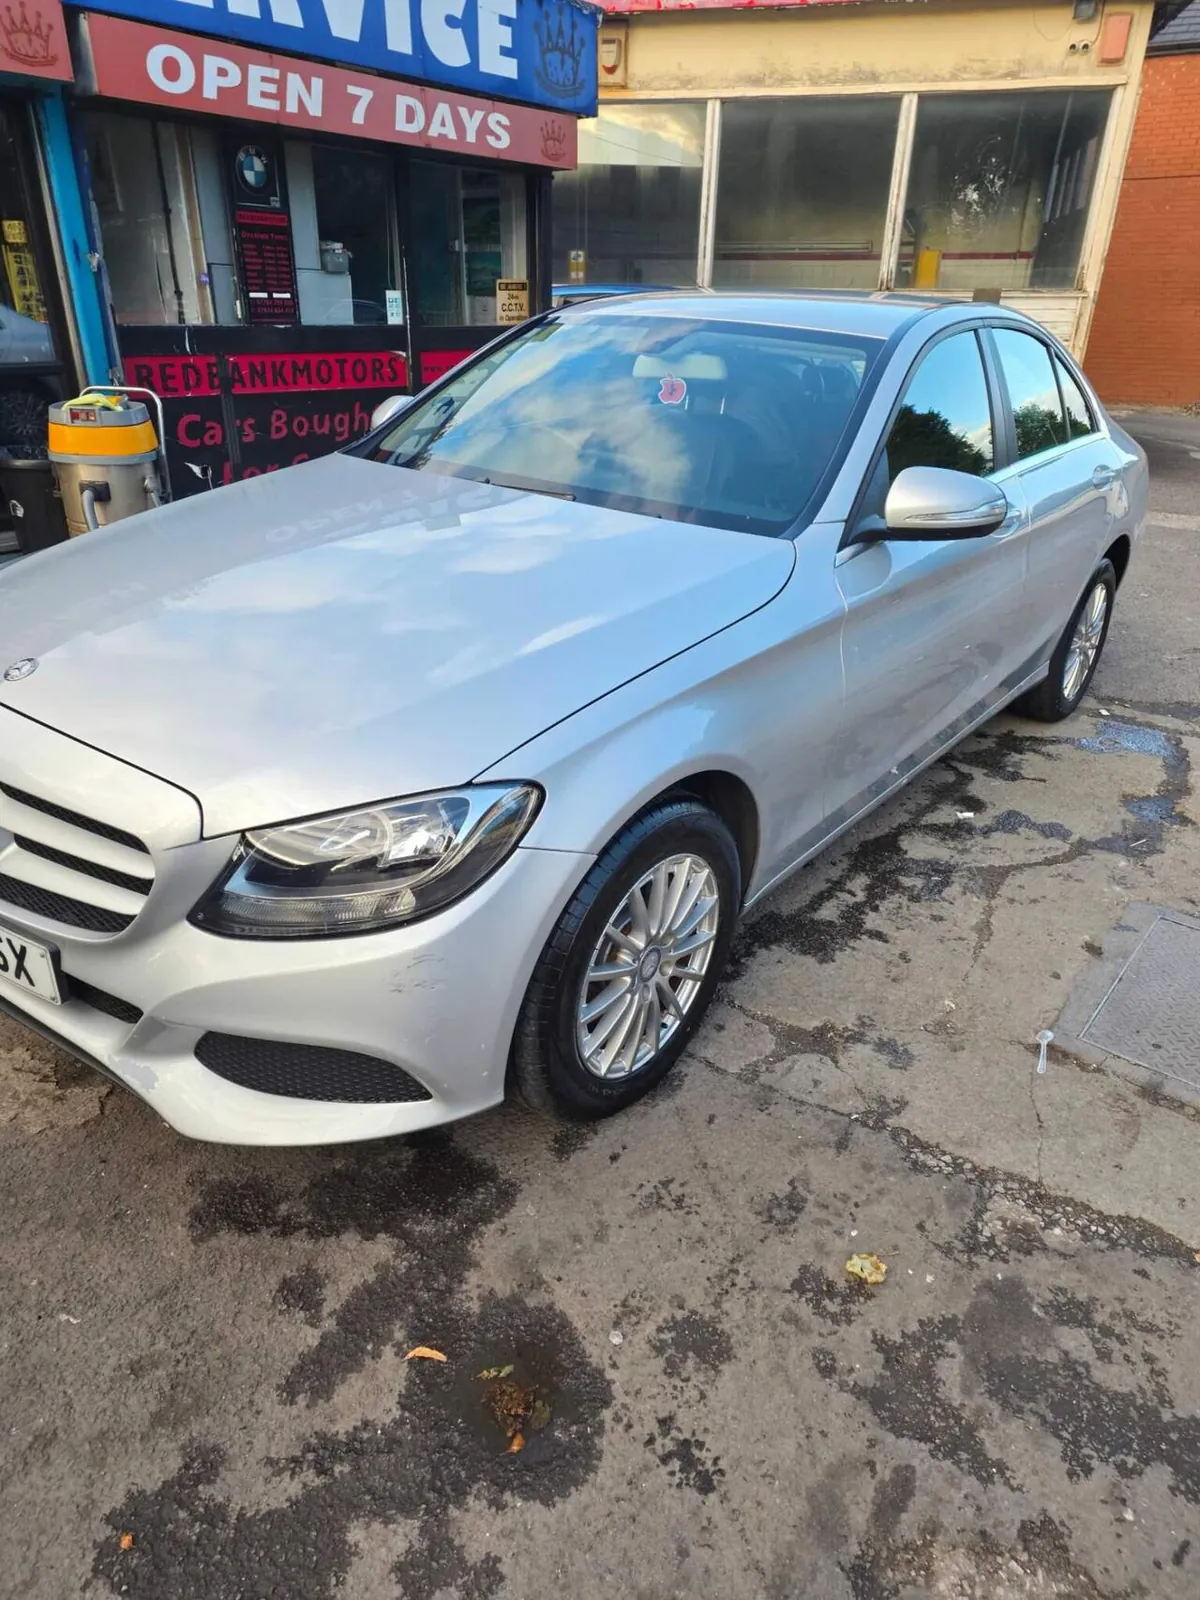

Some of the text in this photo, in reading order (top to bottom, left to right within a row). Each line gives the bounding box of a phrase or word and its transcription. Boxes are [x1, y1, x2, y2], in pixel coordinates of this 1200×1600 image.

[174, 0, 518, 79] VICE
[146, 44, 511, 149] OPEN 7 DAYS
[134, 357, 398, 393] REDBANKMOTORS
[177, 413, 256, 448] Cas
